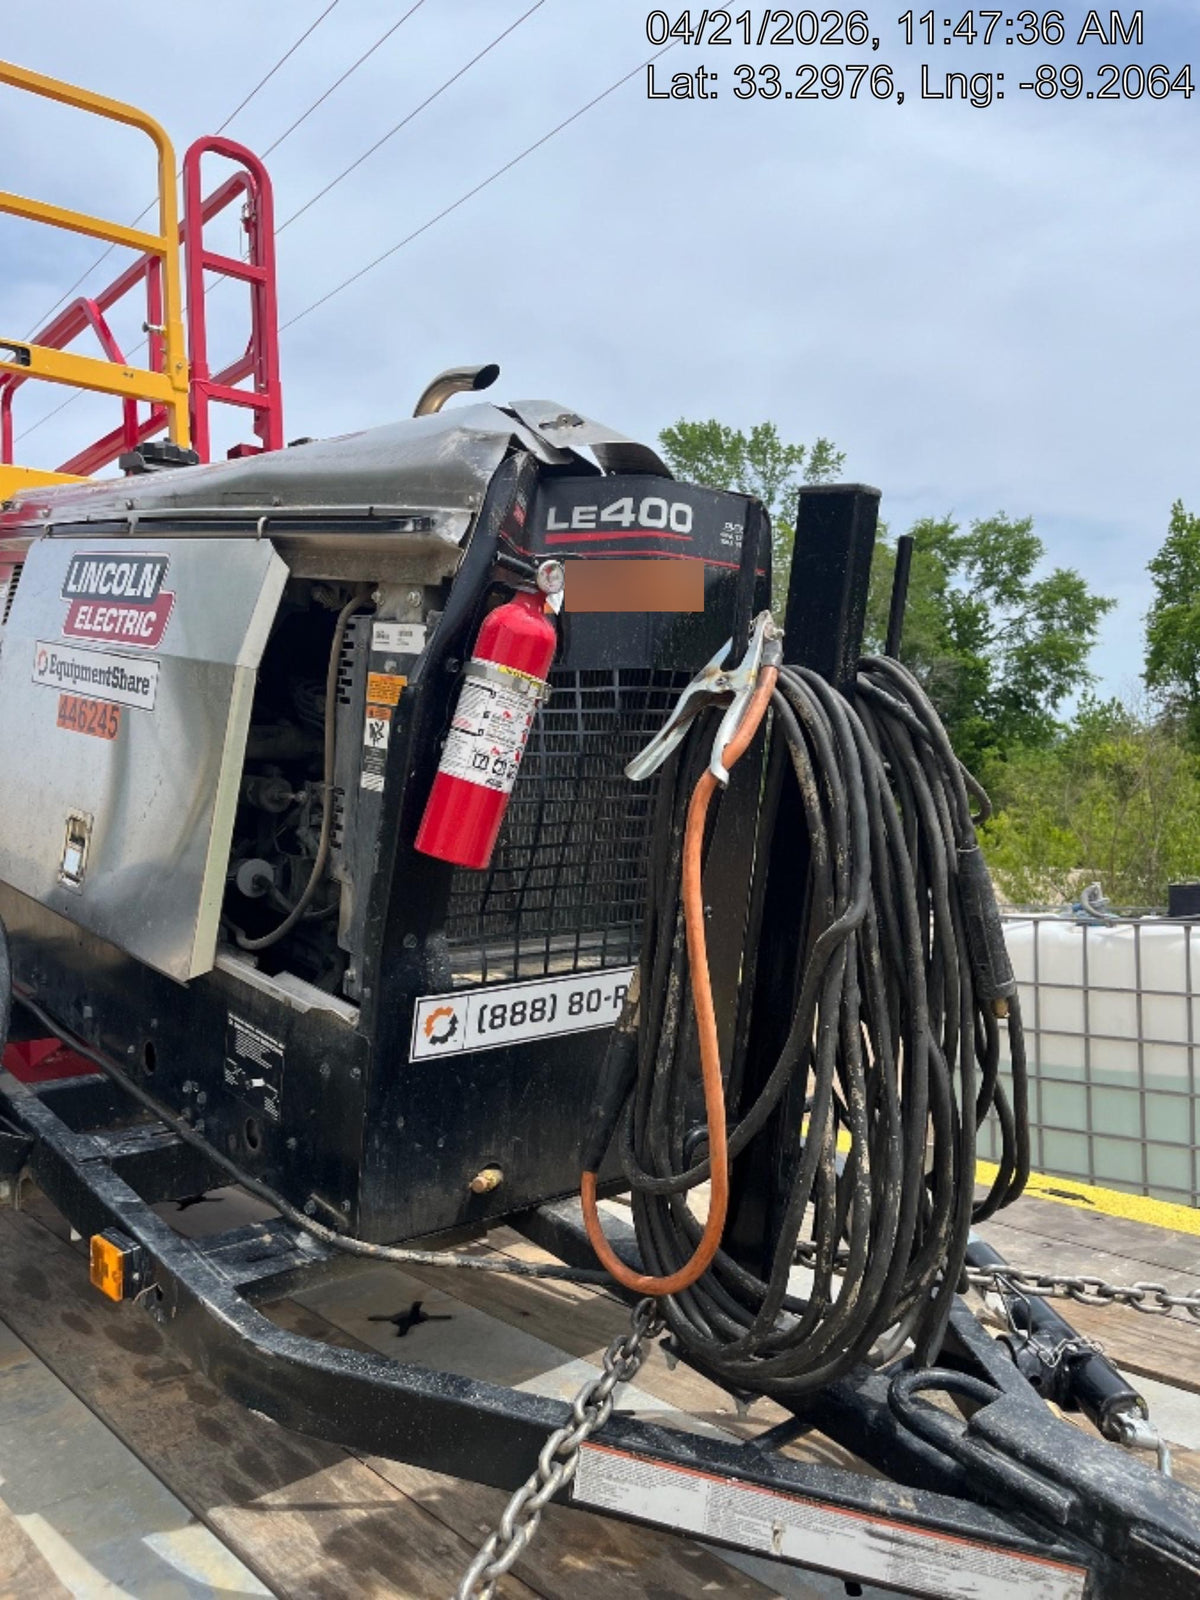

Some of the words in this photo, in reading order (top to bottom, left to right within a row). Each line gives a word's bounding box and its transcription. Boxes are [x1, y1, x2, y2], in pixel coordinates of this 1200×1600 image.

[547, 497, 693, 534] LE400
[67, 560, 161, 598] LINCOLN
[73, 604, 157, 637] ELECTRIC
[49, 655, 150, 696] EquipmentShare
[57, 695, 119, 738] 446245
[477, 993, 557, 1034] (888)
